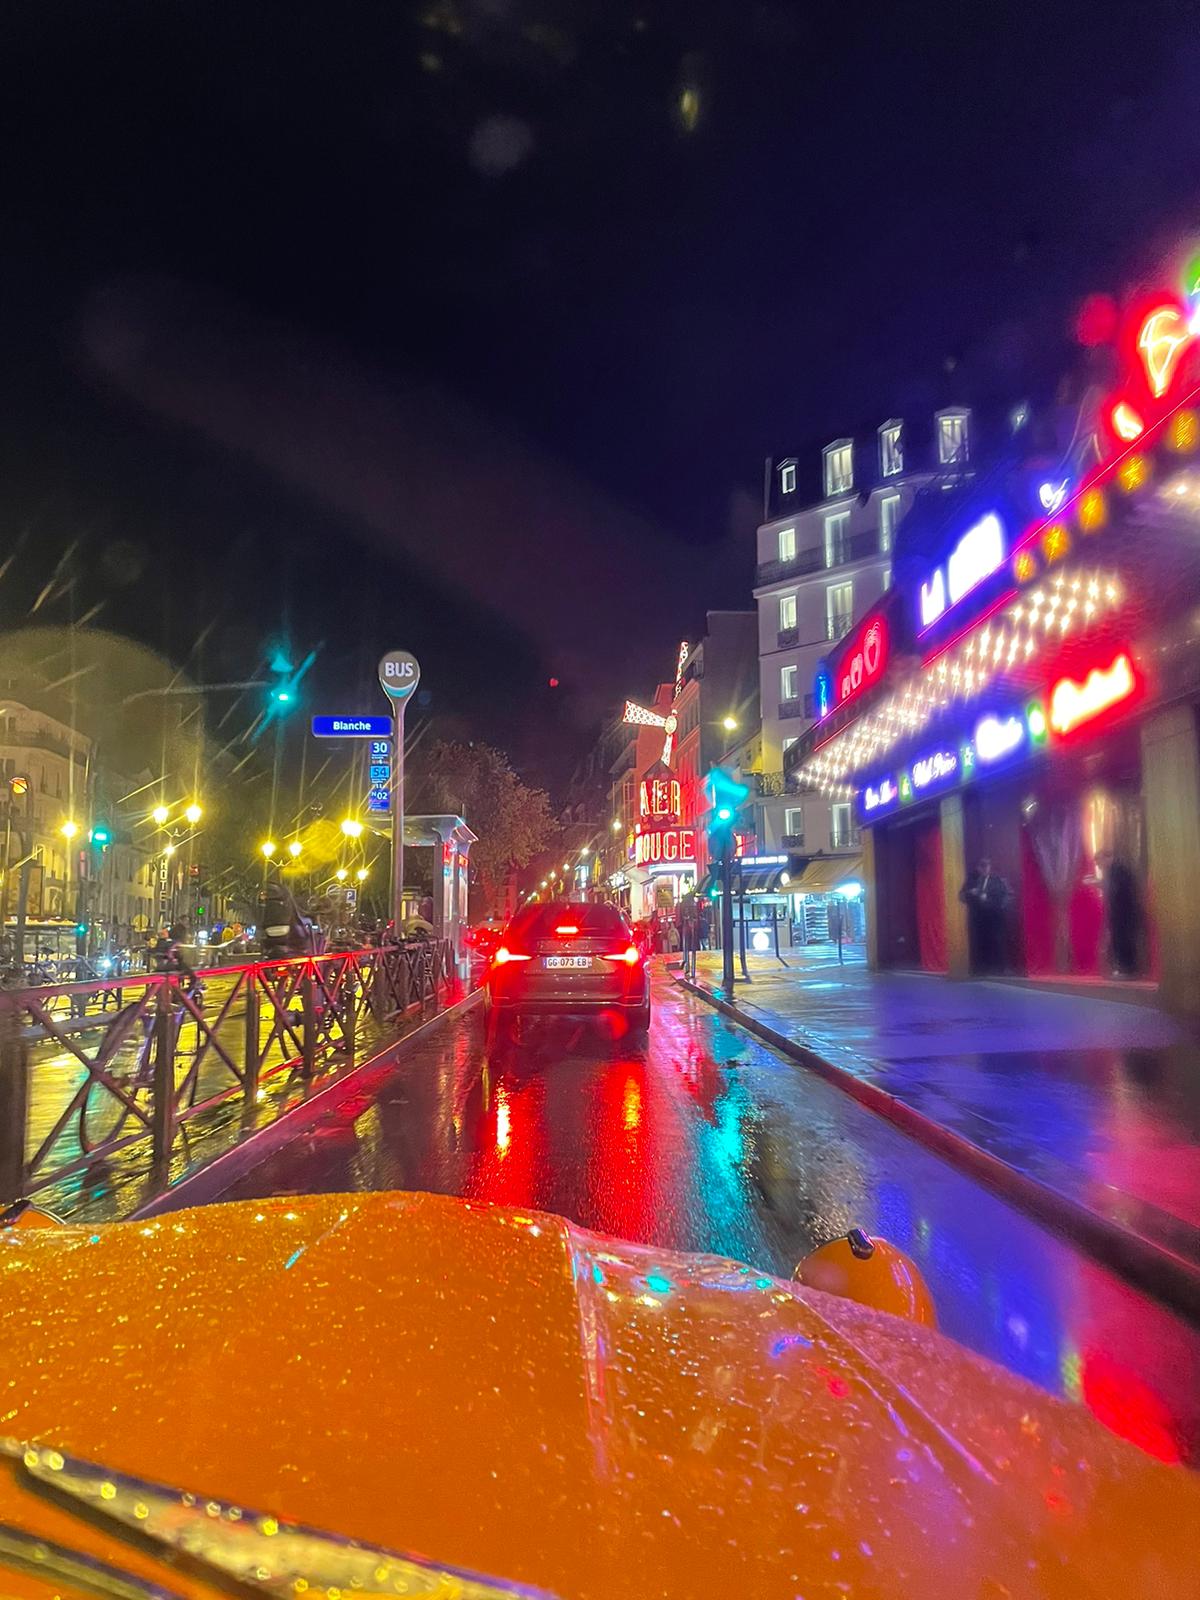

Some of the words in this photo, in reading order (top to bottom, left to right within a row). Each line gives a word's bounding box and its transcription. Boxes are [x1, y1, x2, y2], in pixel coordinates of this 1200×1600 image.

[385, 662, 414, 677] BUS
[333, 721, 371, 730] Blanche
[373, 742, 388, 753] 30
[374, 767, 386, 776] 54
[160, 859, 168, 912] HOTEL
